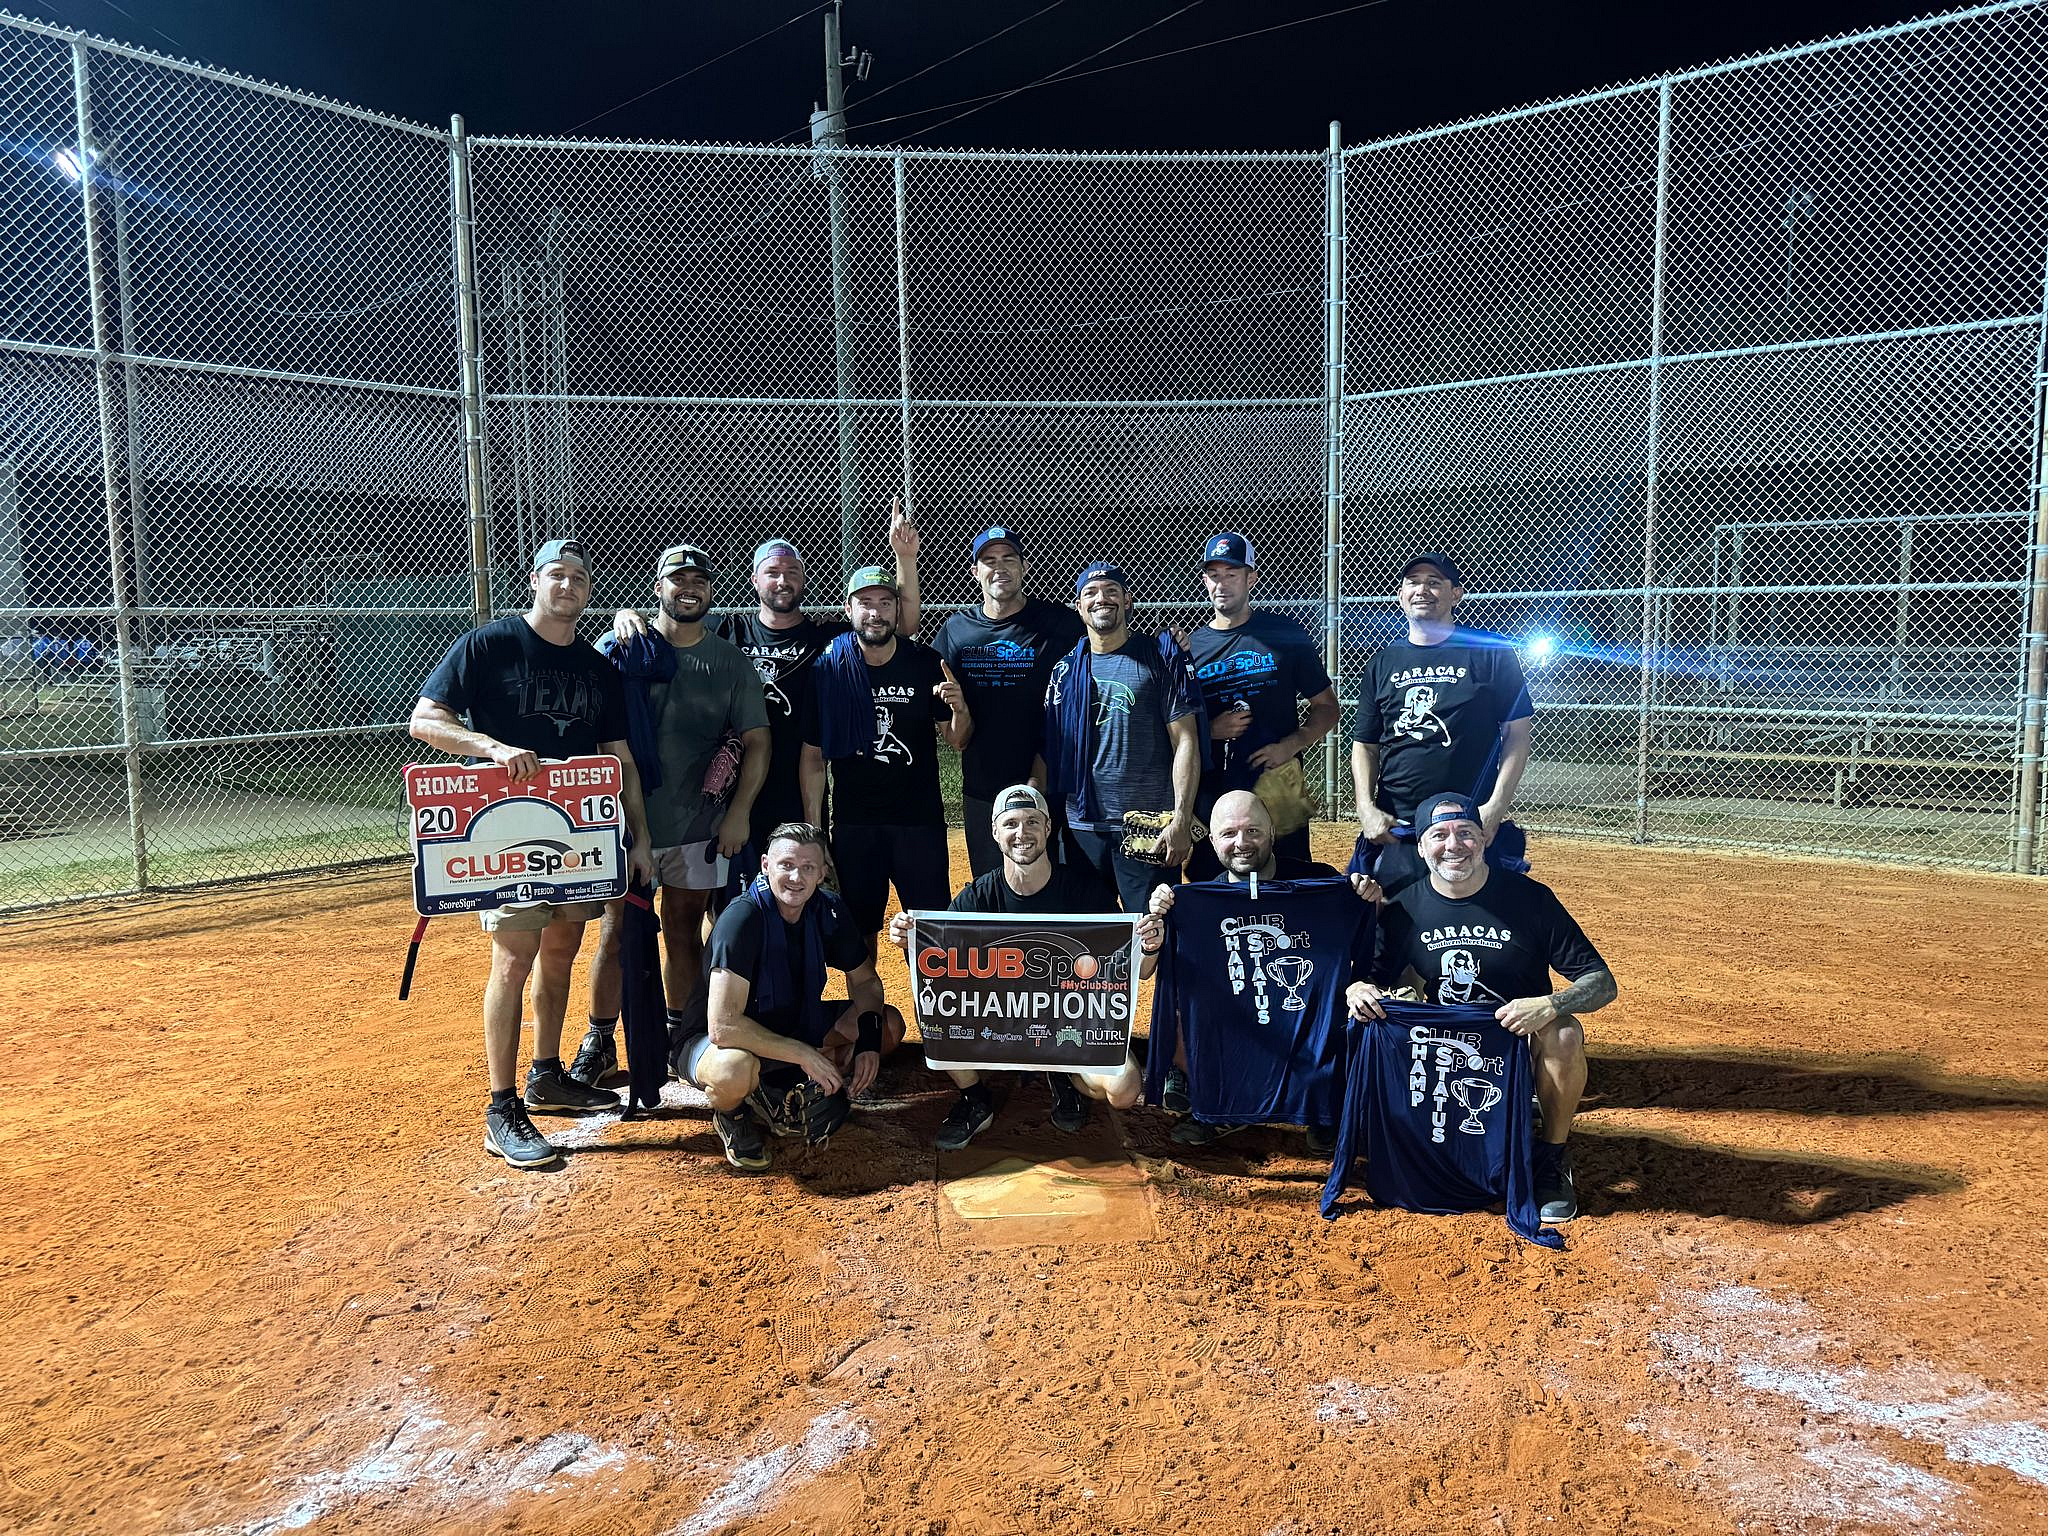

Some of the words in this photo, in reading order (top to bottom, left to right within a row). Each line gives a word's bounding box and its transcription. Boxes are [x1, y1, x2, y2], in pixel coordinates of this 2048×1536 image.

[1390, 666, 1467, 683] CARACAS
[415, 774, 480, 796] HOME
[549, 766, 615, 788] GUEST
[419, 807, 455, 833] 20
[582, 796, 615, 822] 16
[446, 847, 603, 879] CLUBSport
[496, 890, 516, 900] INNING
[519, 884, 531, 899] 4
[534, 886, 555, 896] PERIOD
[1420, 925, 1512, 943] CARACAS
[1427, 939, 1461, 951] Southern
[1461, 937, 1503, 950] Merchants
[918, 946, 1129, 986] CLUBSport
[1060, 980, 1128, 992] #MyClubSport
[1247, 933, 1271, 1025] STATUS
[937, 991, 1129, 1020] CHAMPIONS
[1432, 1046, 1453, 1144] STATUS
